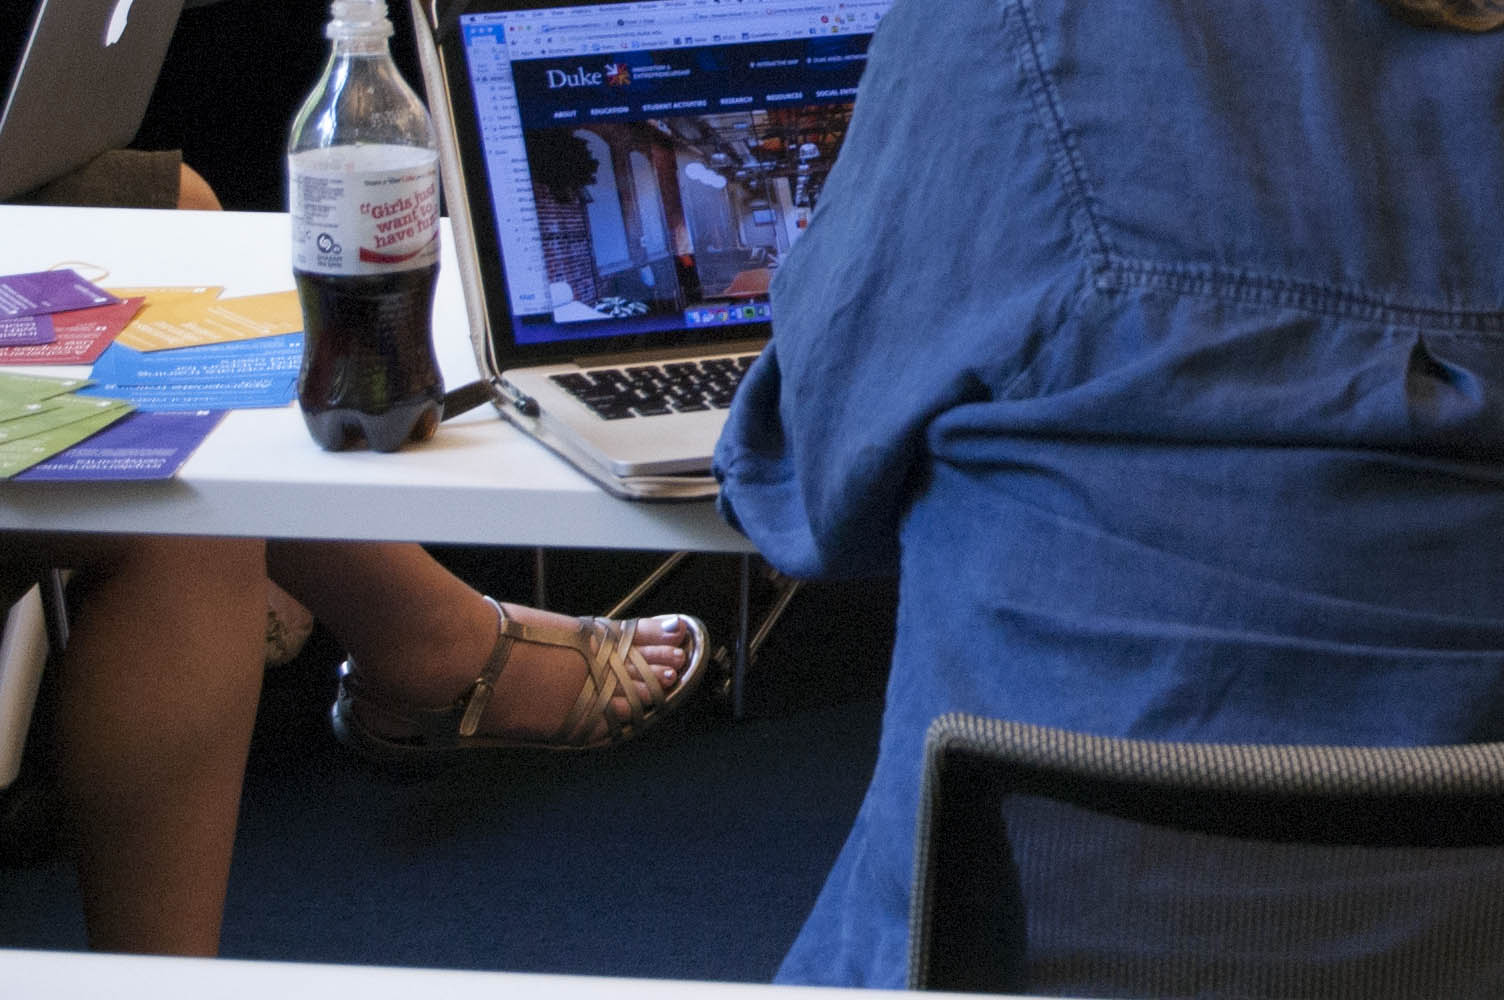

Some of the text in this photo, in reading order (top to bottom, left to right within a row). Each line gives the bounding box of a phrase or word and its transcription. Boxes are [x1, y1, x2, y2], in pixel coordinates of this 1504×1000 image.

[546, 66, 603, 89] Duke
[765, 92, 804, 101] RESOURCES
[815, 90, 838, 98] SOCIAL
[720, 97, 753, 105] RESEARCH
[590, 106, 630, 116] EDUCATION
[642, 103, 673, 112] STUDENT
[376, 203, 432, 233] want to
[373, 228, 414, 248] have
